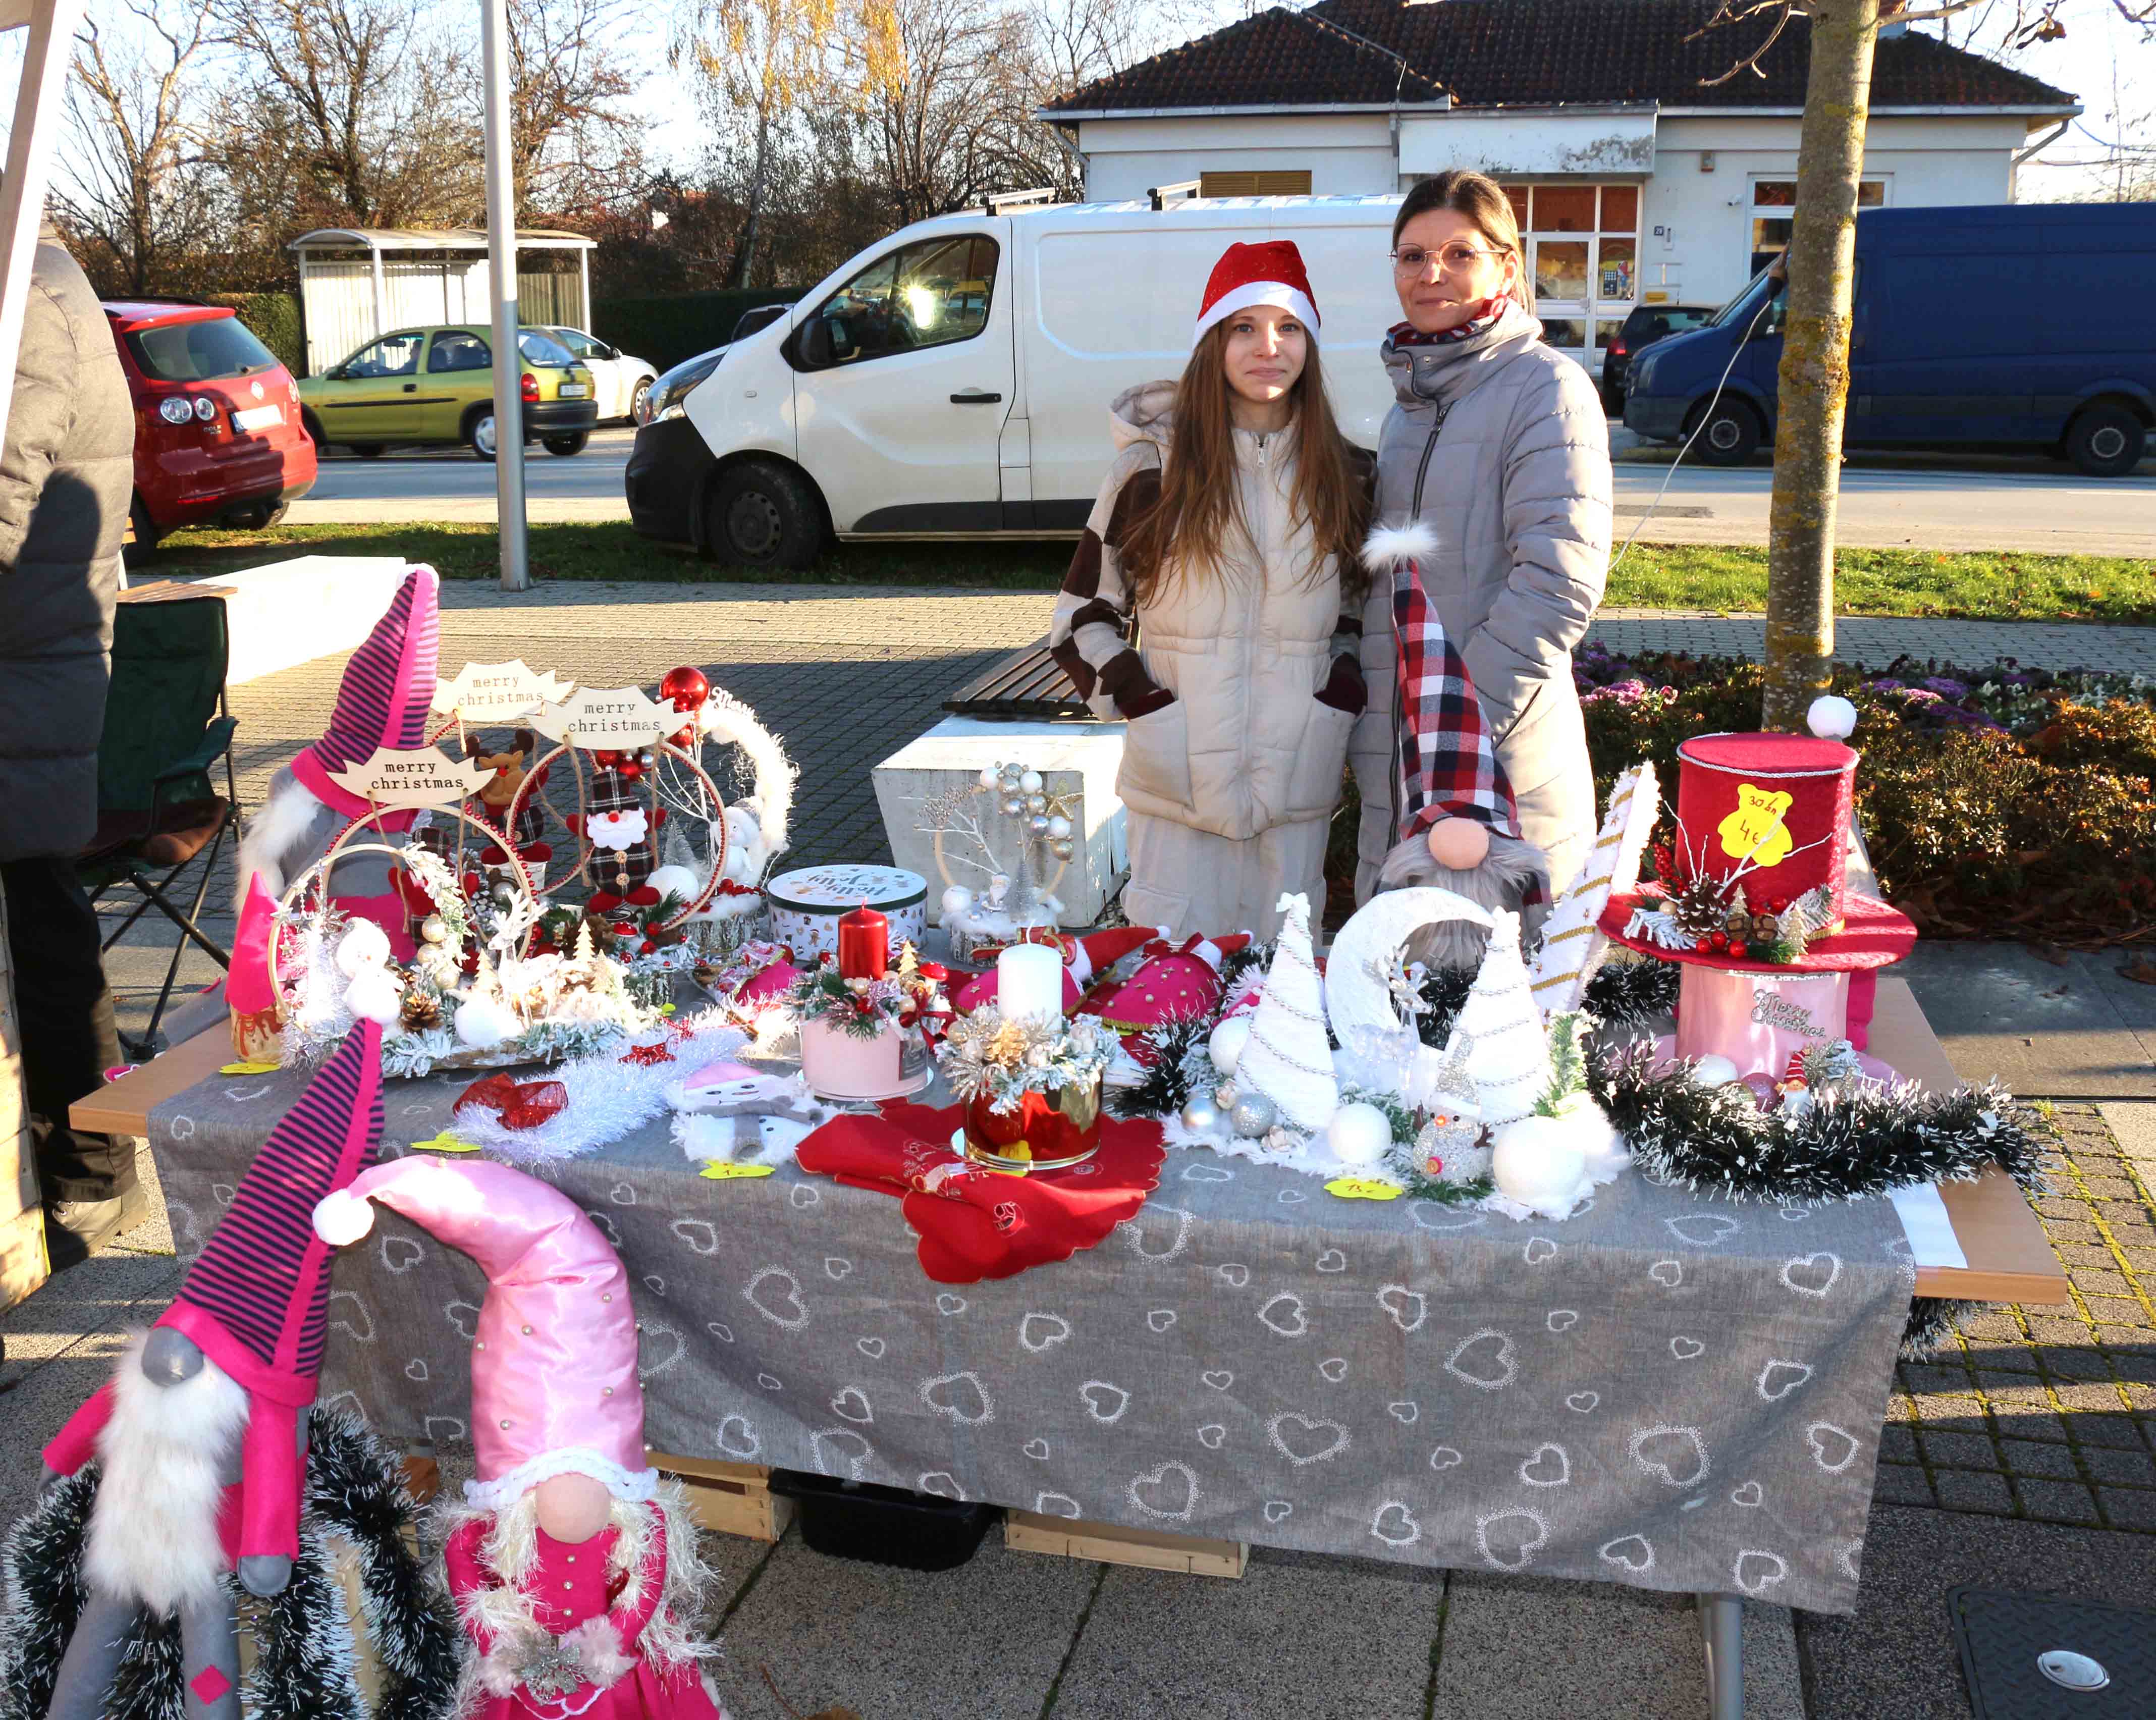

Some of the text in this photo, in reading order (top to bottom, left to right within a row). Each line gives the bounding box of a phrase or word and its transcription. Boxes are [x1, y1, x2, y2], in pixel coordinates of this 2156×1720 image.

[472, 676, 519, 687] merry
[457, 692, 544, 706] christmas
[584, 703, 636, 715] merry
[568, 719, 660, 732] christmas
[385, 763, 436, 774] merry
[371, 777, 464, 789] christmas
[1753, 989, 1812, 1020] Merry
